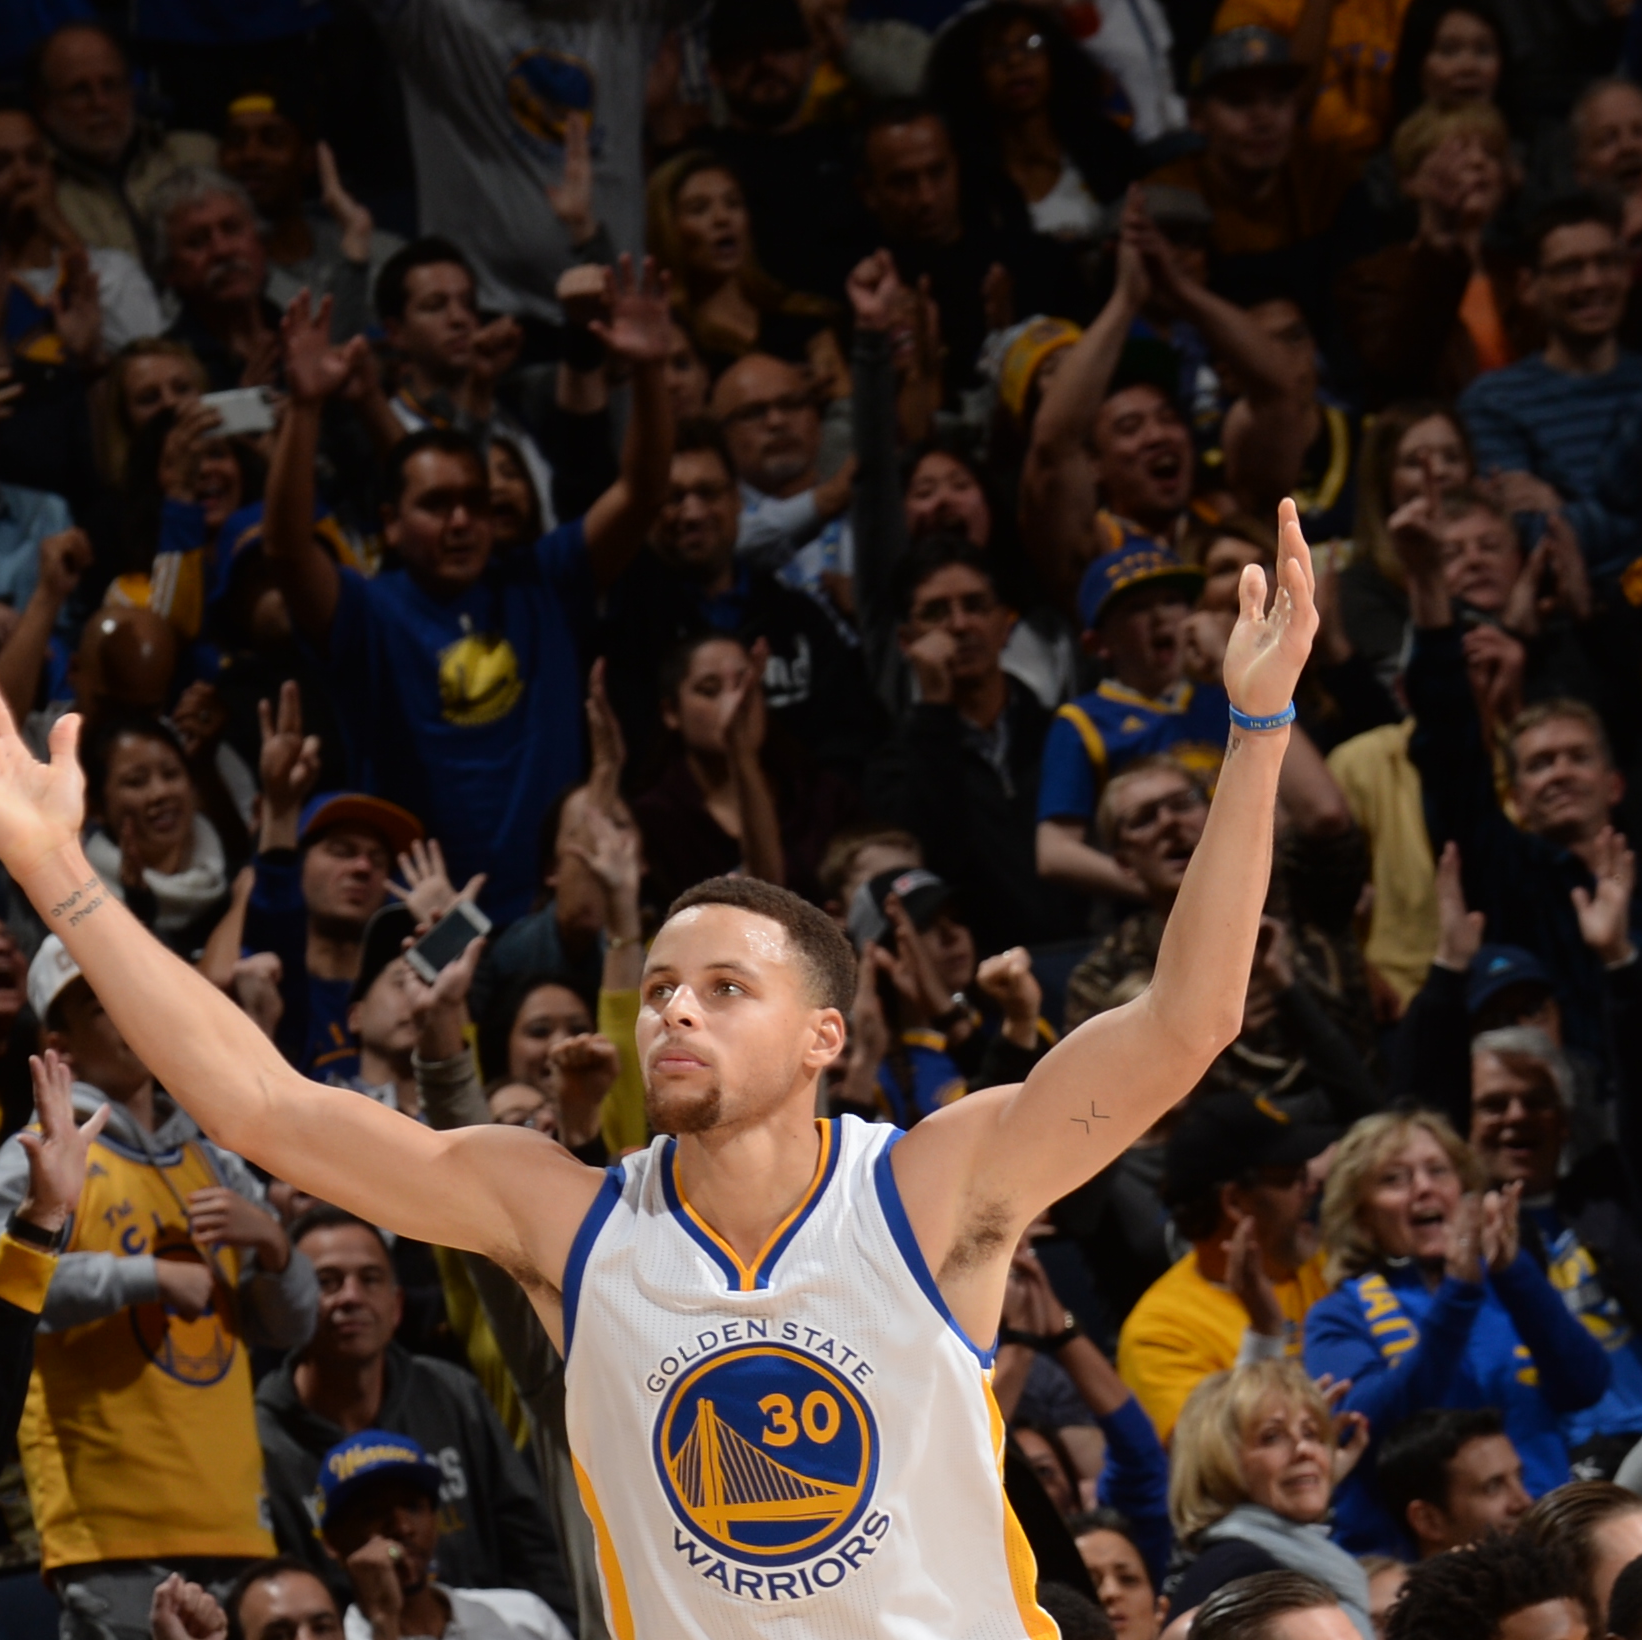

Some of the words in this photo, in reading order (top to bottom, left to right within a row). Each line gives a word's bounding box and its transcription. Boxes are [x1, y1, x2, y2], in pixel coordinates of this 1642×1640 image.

[646, 1318, 768, 1394] GOLDEN
[781, 1321, 874, 1385] STATE
[758, 1390, 842, 1448] 30
[672, 1509, 891, 1601] WARRIORS
